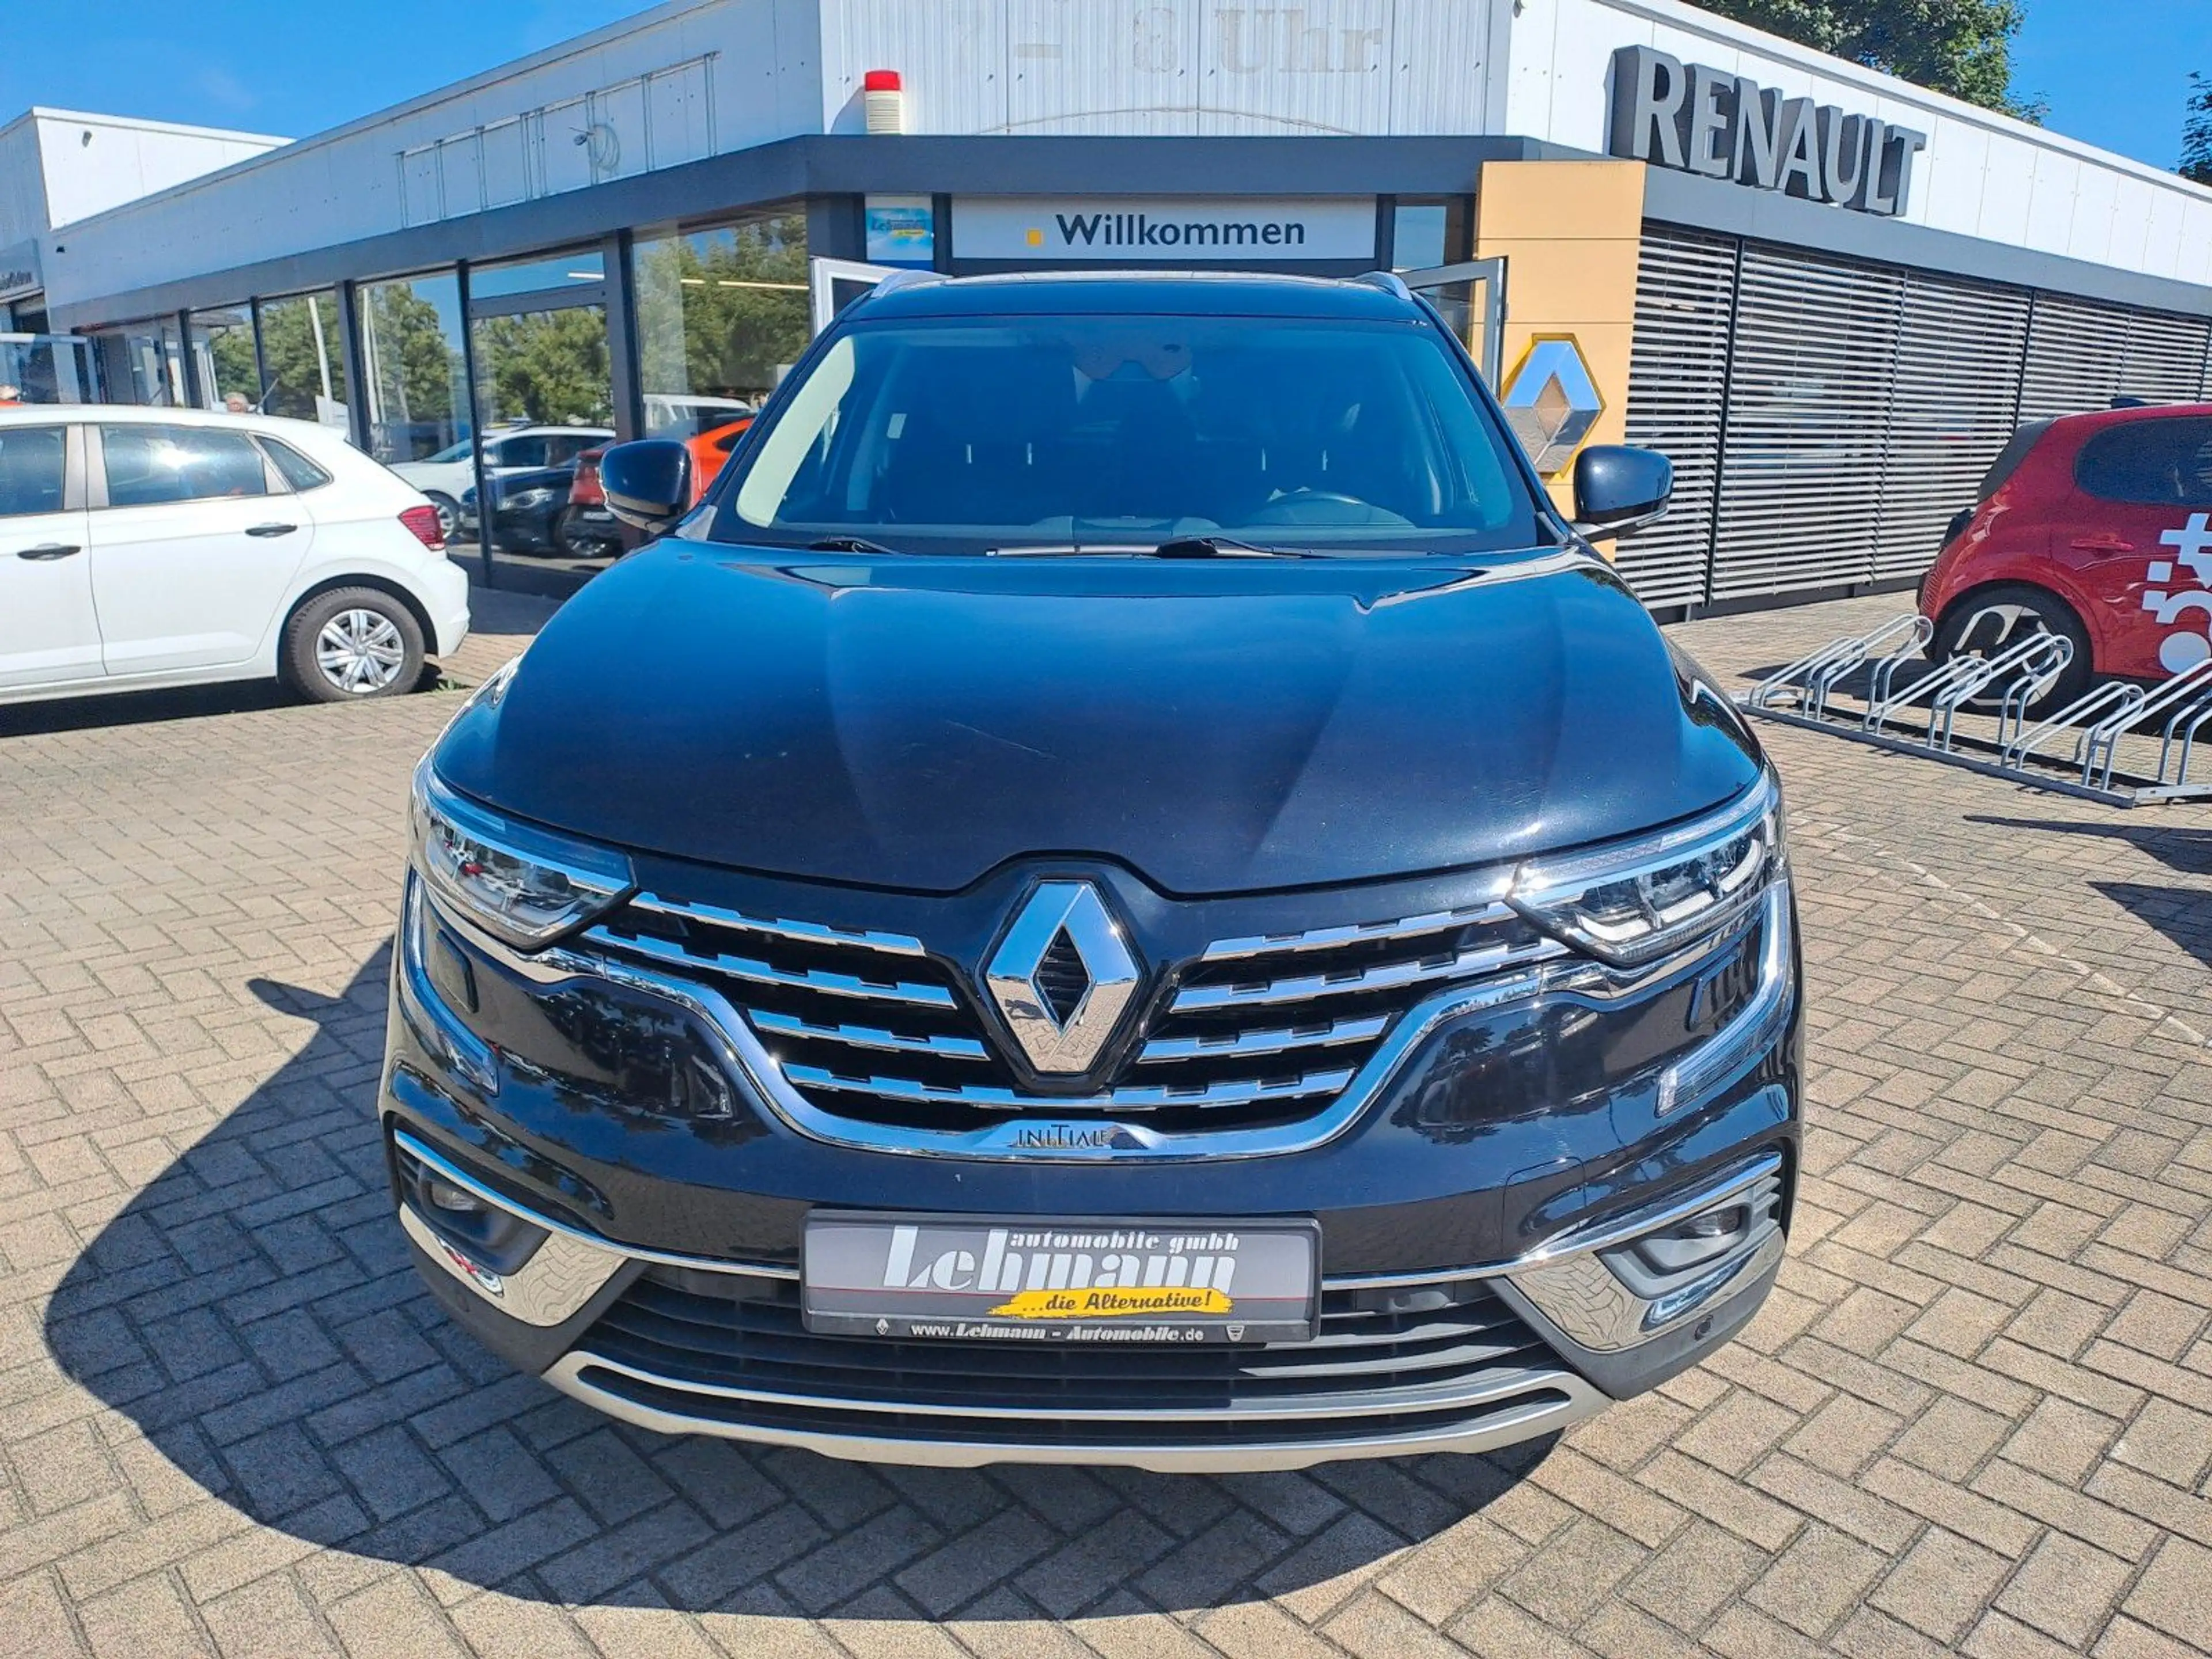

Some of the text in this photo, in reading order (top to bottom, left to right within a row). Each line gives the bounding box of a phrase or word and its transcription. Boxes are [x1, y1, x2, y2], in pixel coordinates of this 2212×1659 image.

[1214, 8, 1384, 74] Uhr
[1613, 44, 1926, 217] RENAULT
[1055, 214, 1305, 245] Willkommen
[1010, 1230, 1239, 1254] automobile gmbh
[883, 1225, 1236, 1294] Lehmann
[1084, 1291, 1212, 1310] Alternative!
[910, 1323, 1046, 1339] www.Lehmann
[1066, 1325, 1205, 1341] Automobile.de
